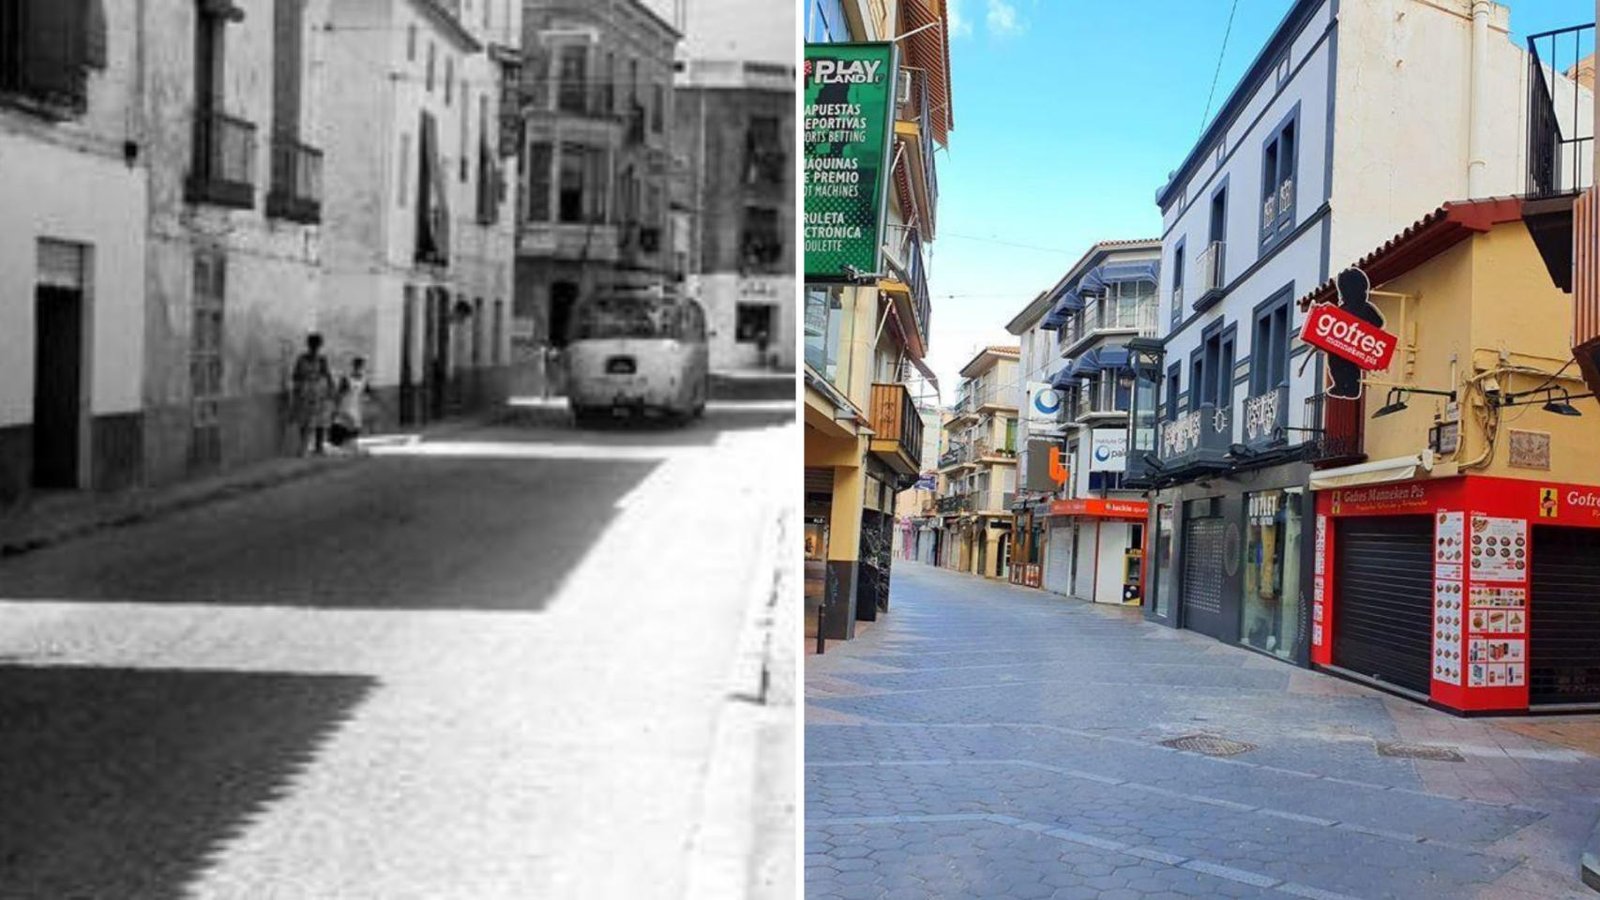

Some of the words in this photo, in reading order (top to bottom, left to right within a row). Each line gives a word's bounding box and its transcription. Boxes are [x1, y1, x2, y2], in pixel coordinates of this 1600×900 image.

[815, 60, 881, 83] PLAY
[823, 74, 867, 84] LAND
[804, 104, 861, 116] APUESTAS
[828, 131, 866, 142] BETTING
[813, 171, 860, 183] PREMIO
[814, 185, 859, 197] MACHINES
[1315, 314, 1388, 358] gofres
[1249, 496, 1277, 517] OUTLET
